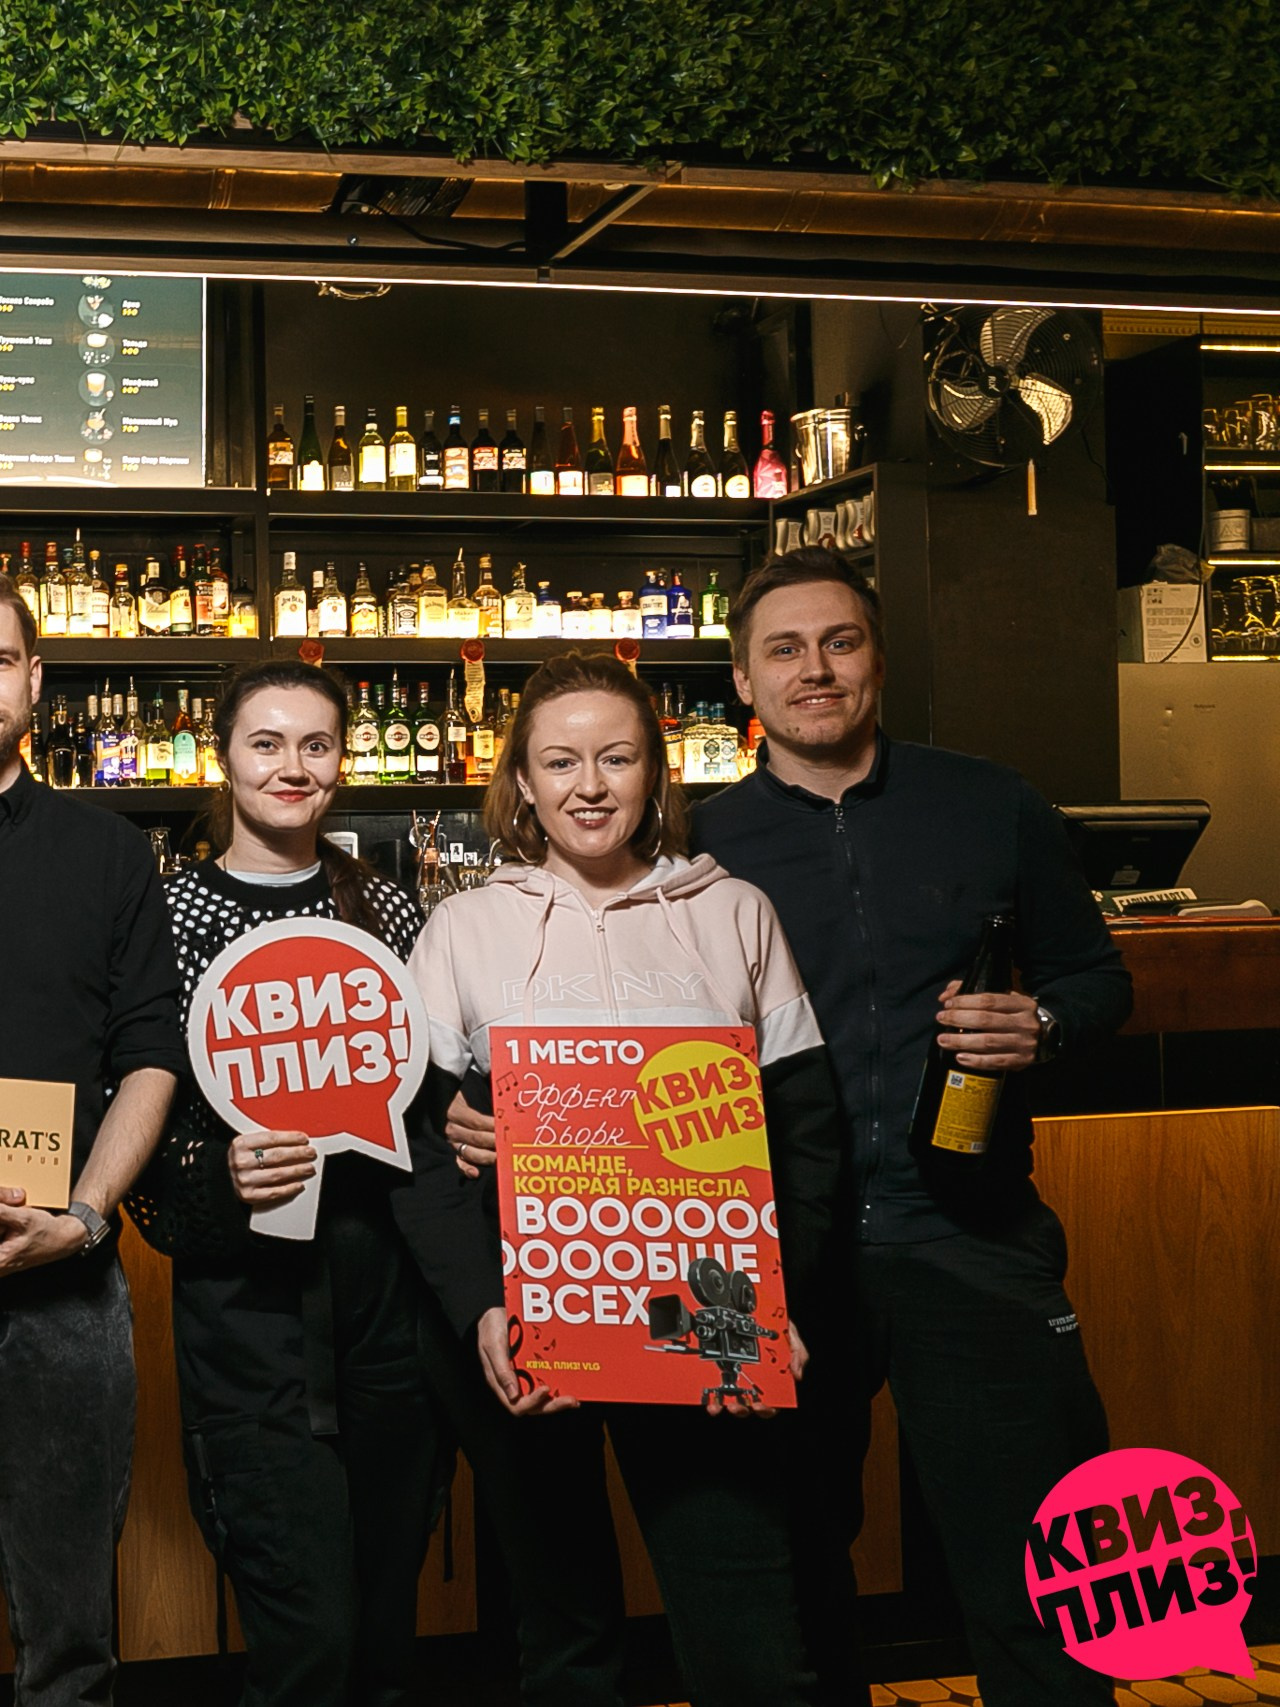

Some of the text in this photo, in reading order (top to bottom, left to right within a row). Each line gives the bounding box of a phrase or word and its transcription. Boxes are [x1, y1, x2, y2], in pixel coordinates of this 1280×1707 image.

[506, 1040, 645, 1066] 1 МЕСТО
[642, 1096, 765, 1151] ПЛИЗ
[26, 1154, 60, 1166] PUB
[512, 1154, 634, 1177] КОМАНДЕ,
[514, 1176, 751, 1197] КОТОРАЯ РАЗНЕСЛА
[521, 1283, 652, 1325] ВСЕХ
[582, 1361, 601, 1371] VLG
